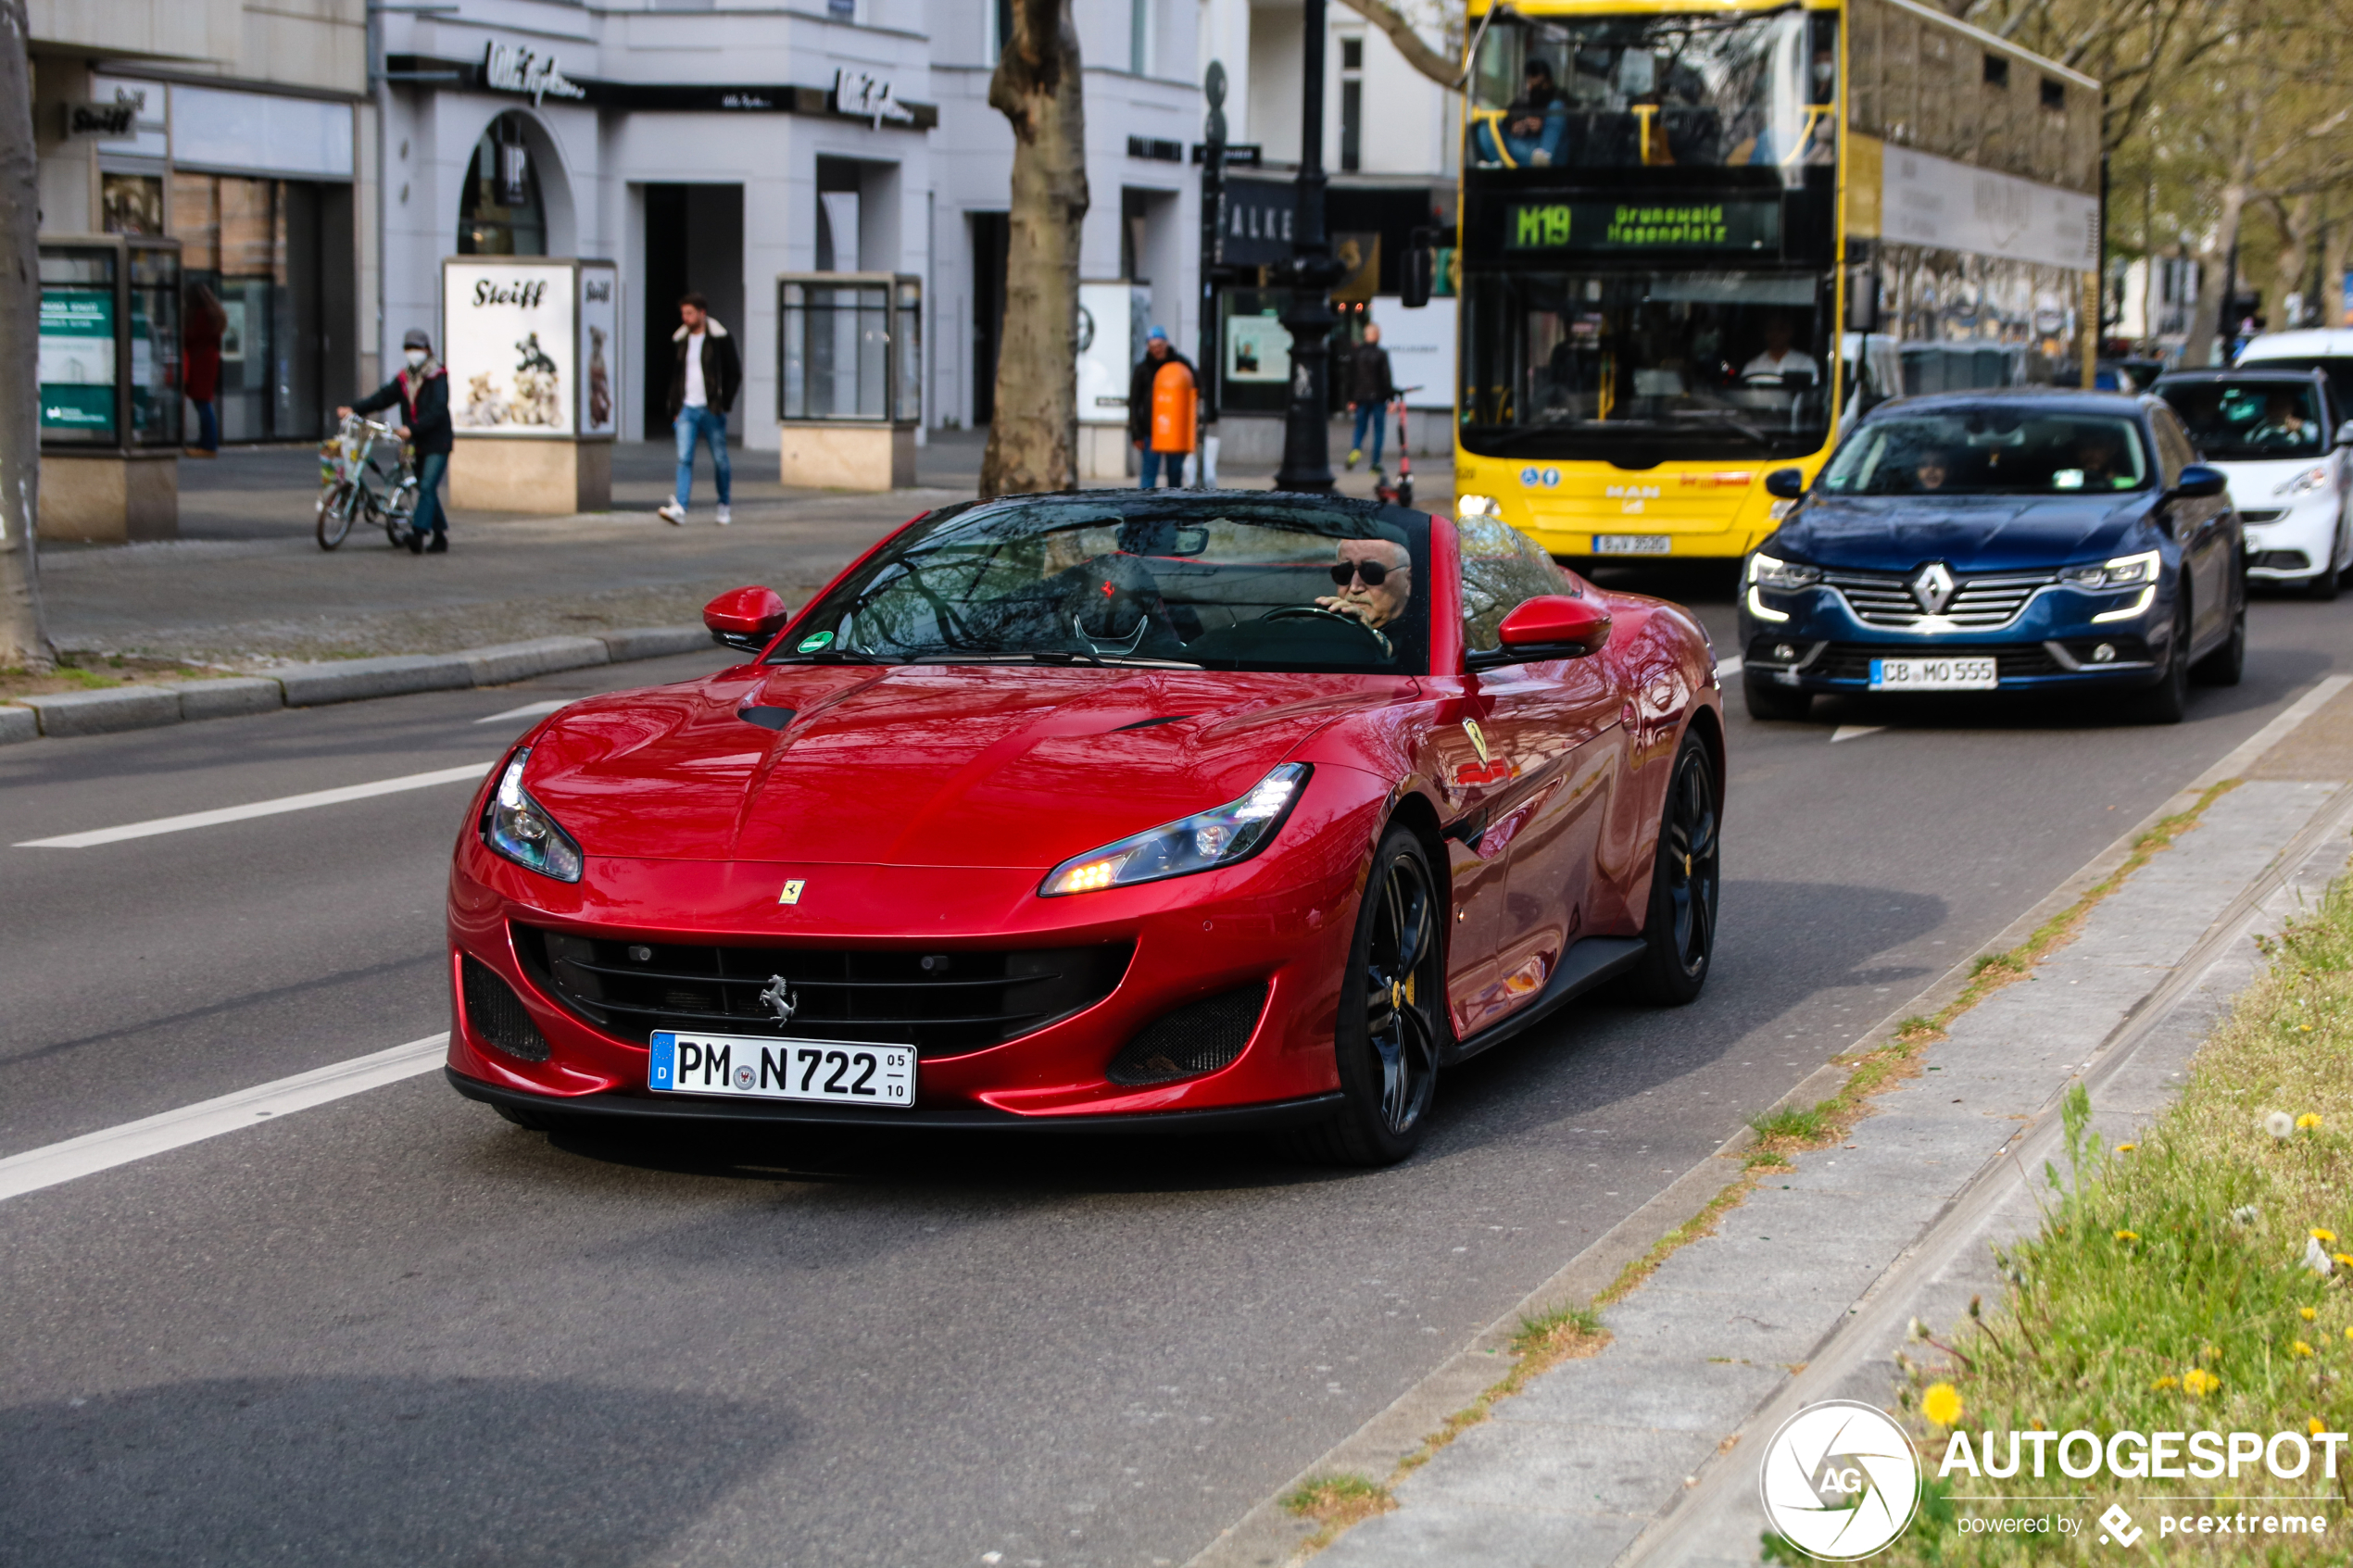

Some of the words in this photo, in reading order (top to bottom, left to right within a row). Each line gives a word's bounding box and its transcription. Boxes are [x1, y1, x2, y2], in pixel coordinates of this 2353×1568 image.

[1230, 203, 1293, 241] ALKE
[1517, 205, 1571, 245] M19
[1607, 223, 1727, 244] Hagenplatz
[473, 279, 548, 309] Steiff
[1605, 484, 1660, 499] MAN
[1883, 662, 1910, 682] CB
[1923, 662, 1950, 682] MO
[1954, 662, 1994, 681] 555
[678, 1041, 731, 1086] PM
[761, 1046, 787, 1090] N
[798, 1048, 877, 1096] 722
[887, 1054, 906, 1066] 05
[887, 1085, 904, 1098] 10
